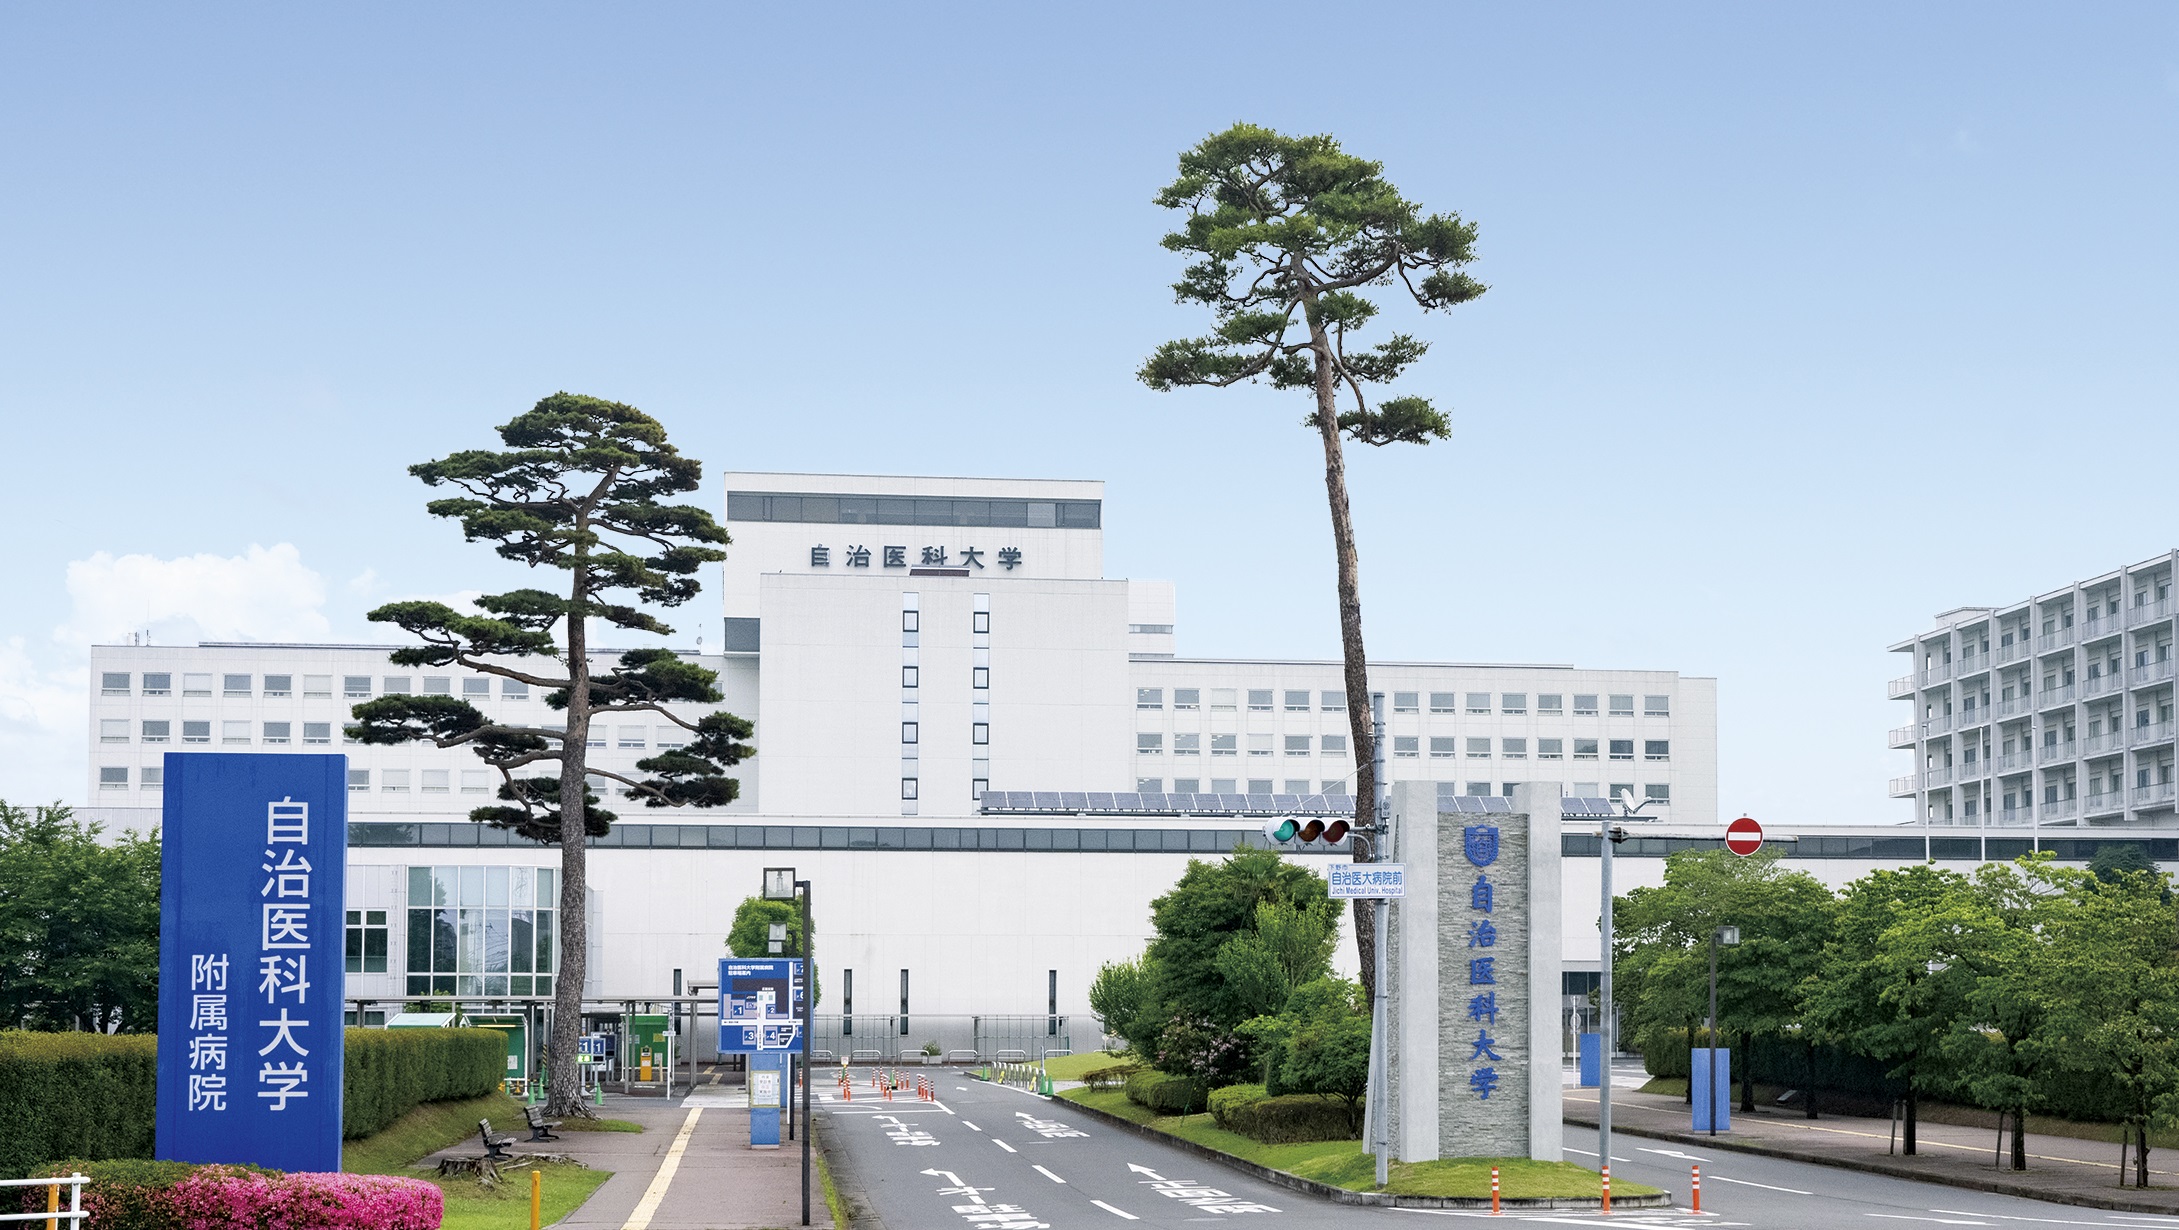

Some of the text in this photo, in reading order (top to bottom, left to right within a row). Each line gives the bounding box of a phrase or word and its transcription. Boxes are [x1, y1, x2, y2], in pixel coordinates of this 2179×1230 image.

[810, 543, 1023, 570] 自治医科大学
[1332, 871, 1402, 886] 自治医大病院前
[1382, 887, 1403, 896] Hospital
[257, 796, 312, 1111] 自治医科大学
[1468, 874, 1502, 1100] 自治医科大学
[188, 954, 229, 1111] 附属病院
